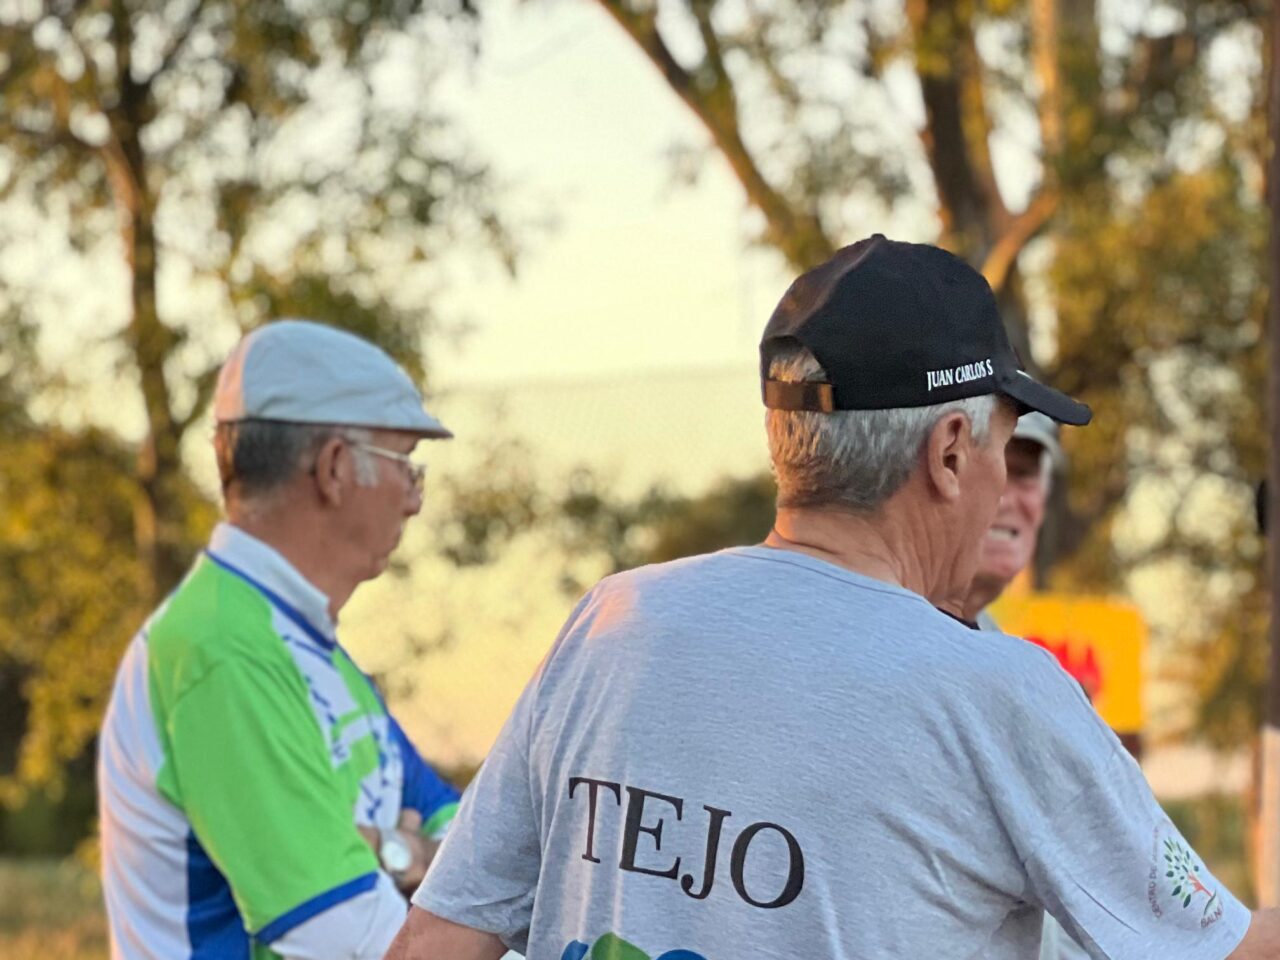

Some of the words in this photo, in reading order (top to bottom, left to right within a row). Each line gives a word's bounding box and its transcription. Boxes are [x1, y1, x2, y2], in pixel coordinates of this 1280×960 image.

[927, 369, 953, 391] JUAN
[955, 361, 986, 383] CARLOS
[986, 359, 993, 375] S
[568, 776, 805, 909] TEJO
